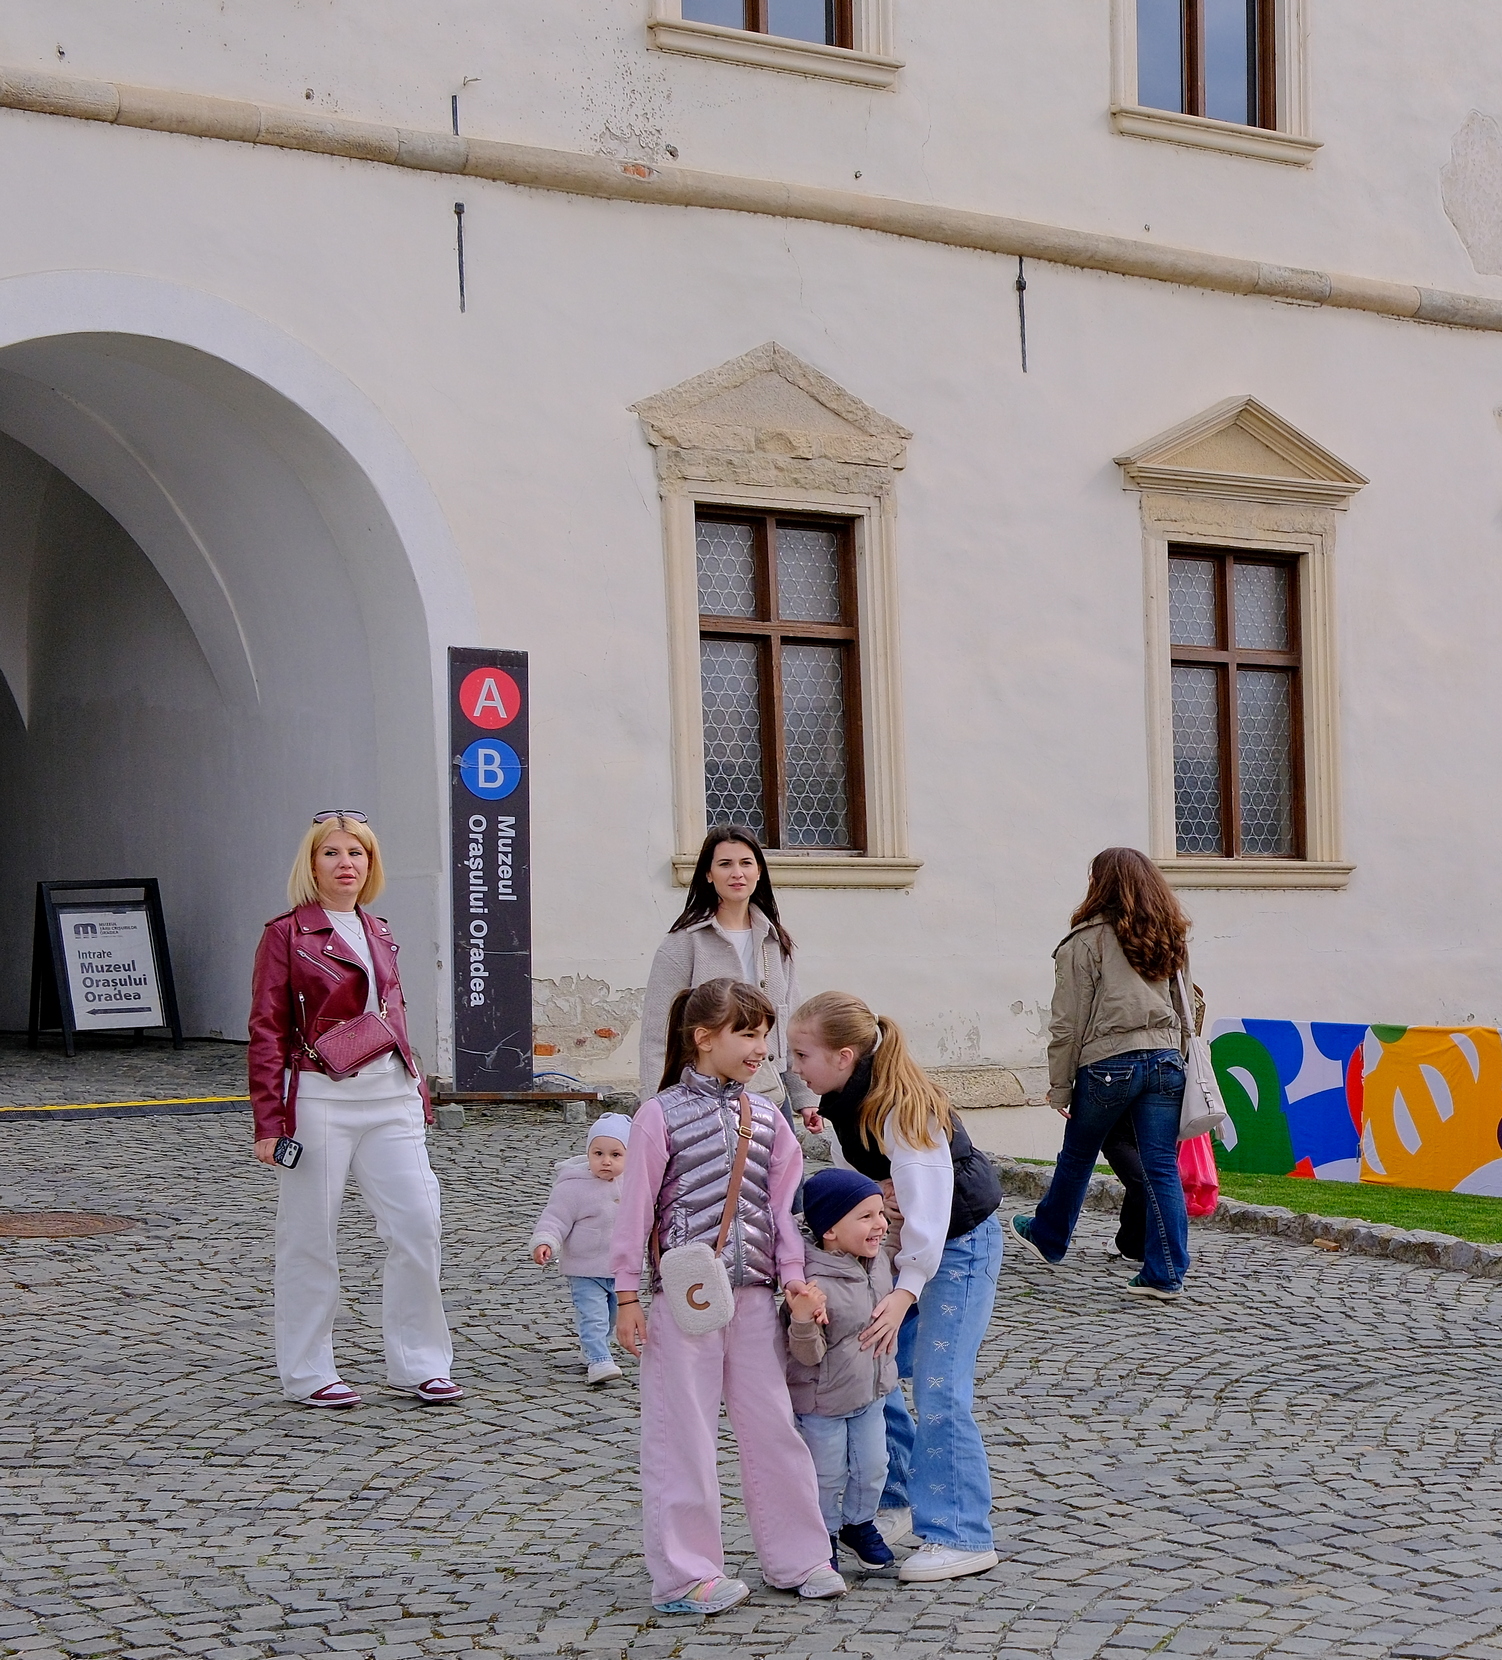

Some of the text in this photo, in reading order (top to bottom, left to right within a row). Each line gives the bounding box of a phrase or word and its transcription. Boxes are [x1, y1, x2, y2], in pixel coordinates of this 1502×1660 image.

[473, 677, 508, 719] A
[478, 748, 505, 788] B
[497, 815, 518, 901] Muzeul
[80, 960, 137, 974] Muzeul
[469, 919, 490, 1007] Oradea
[82, 974, 148, 991] Orașului
[84, 989, 142, 1003] Oradea
[686, 1282, 711, 1311] C
